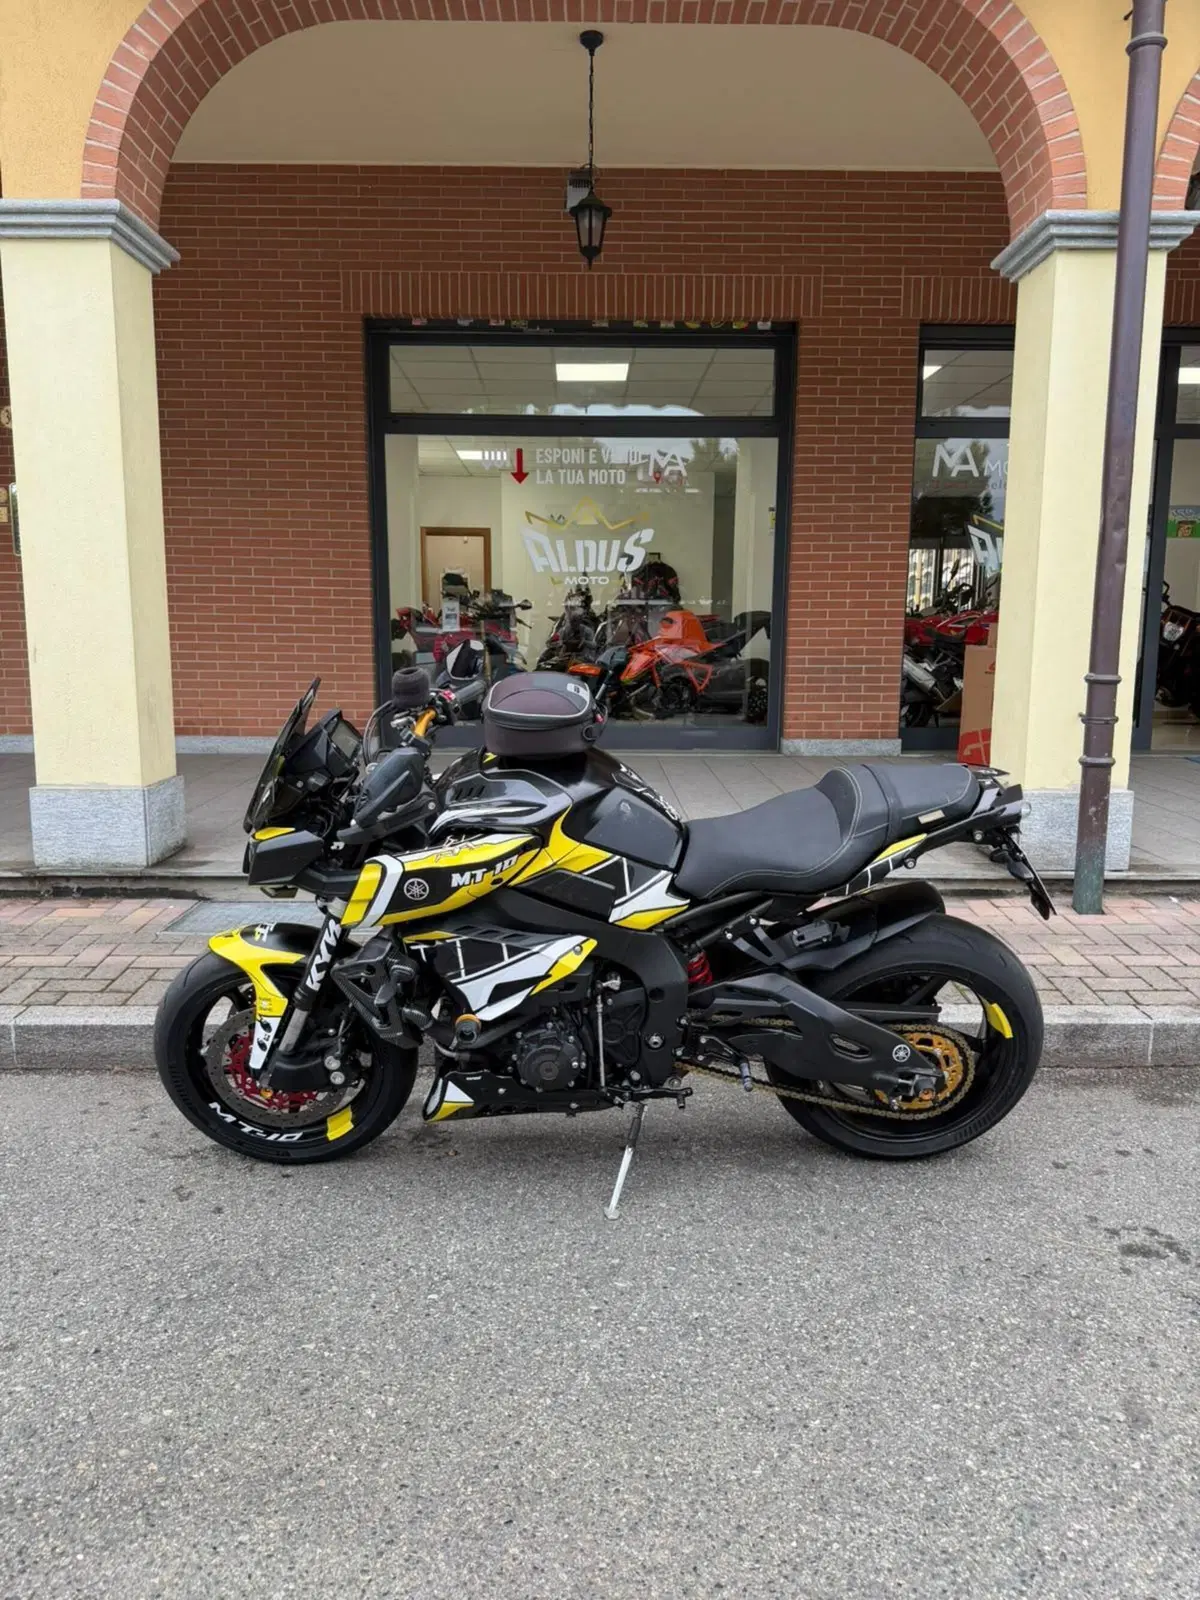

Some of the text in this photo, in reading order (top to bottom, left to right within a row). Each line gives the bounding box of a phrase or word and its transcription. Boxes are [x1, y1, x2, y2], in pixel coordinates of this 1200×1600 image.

[535, 449, 585, 465] ESPONI
[588, 449, 597, 465] E
[536, 469, 626, 485] LA TUA MOTO
[521, 528, 655, 573] ALDUS
[564, 576, 609, 585] MOTO
